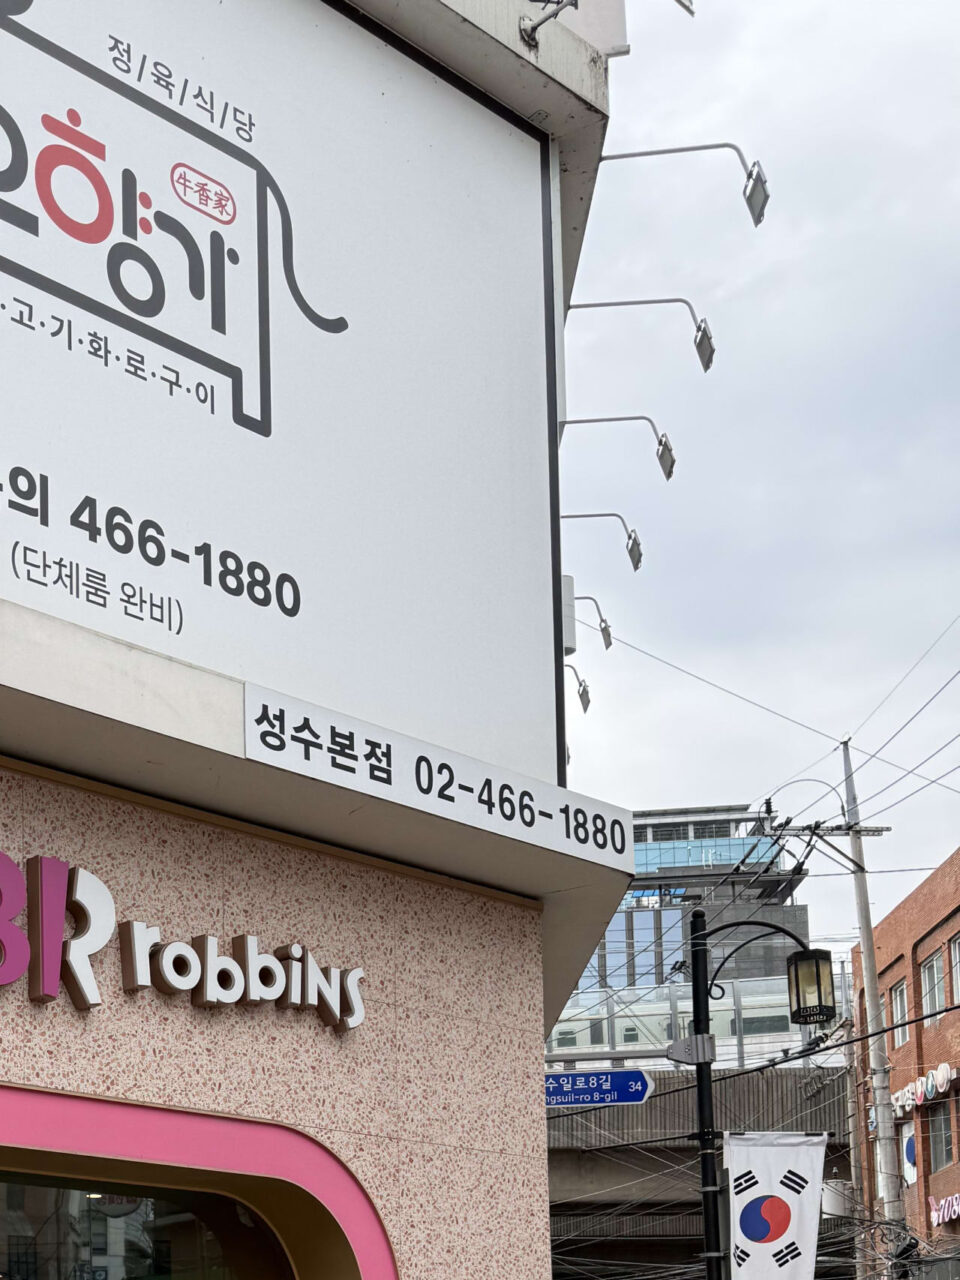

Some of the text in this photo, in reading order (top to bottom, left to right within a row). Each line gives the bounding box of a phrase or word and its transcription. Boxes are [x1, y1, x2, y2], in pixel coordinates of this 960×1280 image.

[10, 540, 184, 635] (단체룸 완비)
[69, 495, 302, 618] 466-1880
[254, 703, 627, 855] 성수본점 02-466-1880
[593, 1092, 618, 1103] 8-gil
[628, 1081, 643, 1092] 34
